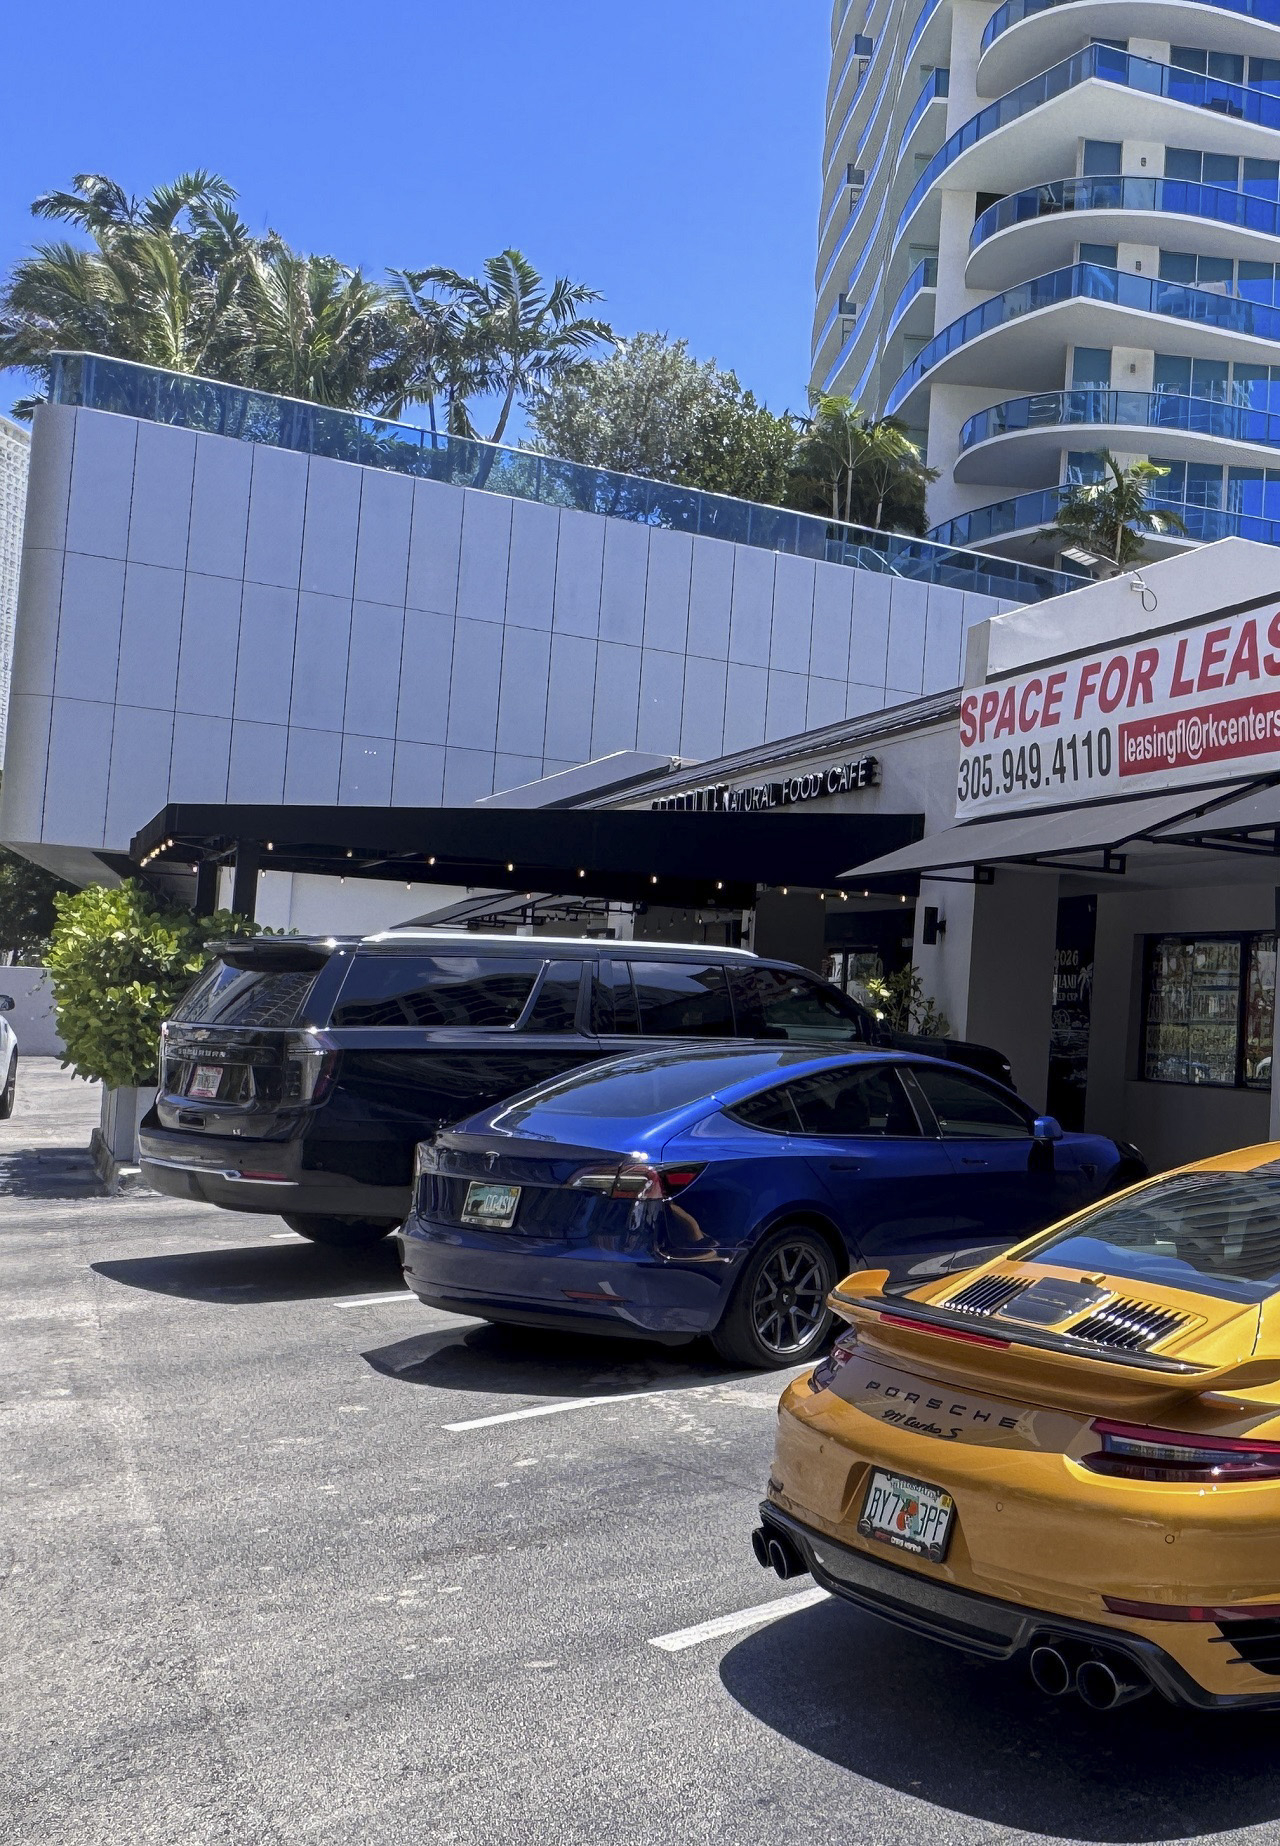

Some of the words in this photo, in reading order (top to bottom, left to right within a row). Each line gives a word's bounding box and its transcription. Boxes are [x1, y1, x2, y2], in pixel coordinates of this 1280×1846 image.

[960, 671, 1067, 748] SPACE
[1074, 647, 1160, 720] FOR
[782, 772, 823, 802] FOOD
[827, 758, 869, 794] CAFE
[957, 727, 1112, 802] 305.949.4110
[866, 1380, 1019, 1429] PORSCHE
[941, 1427, 963, 1439] S
